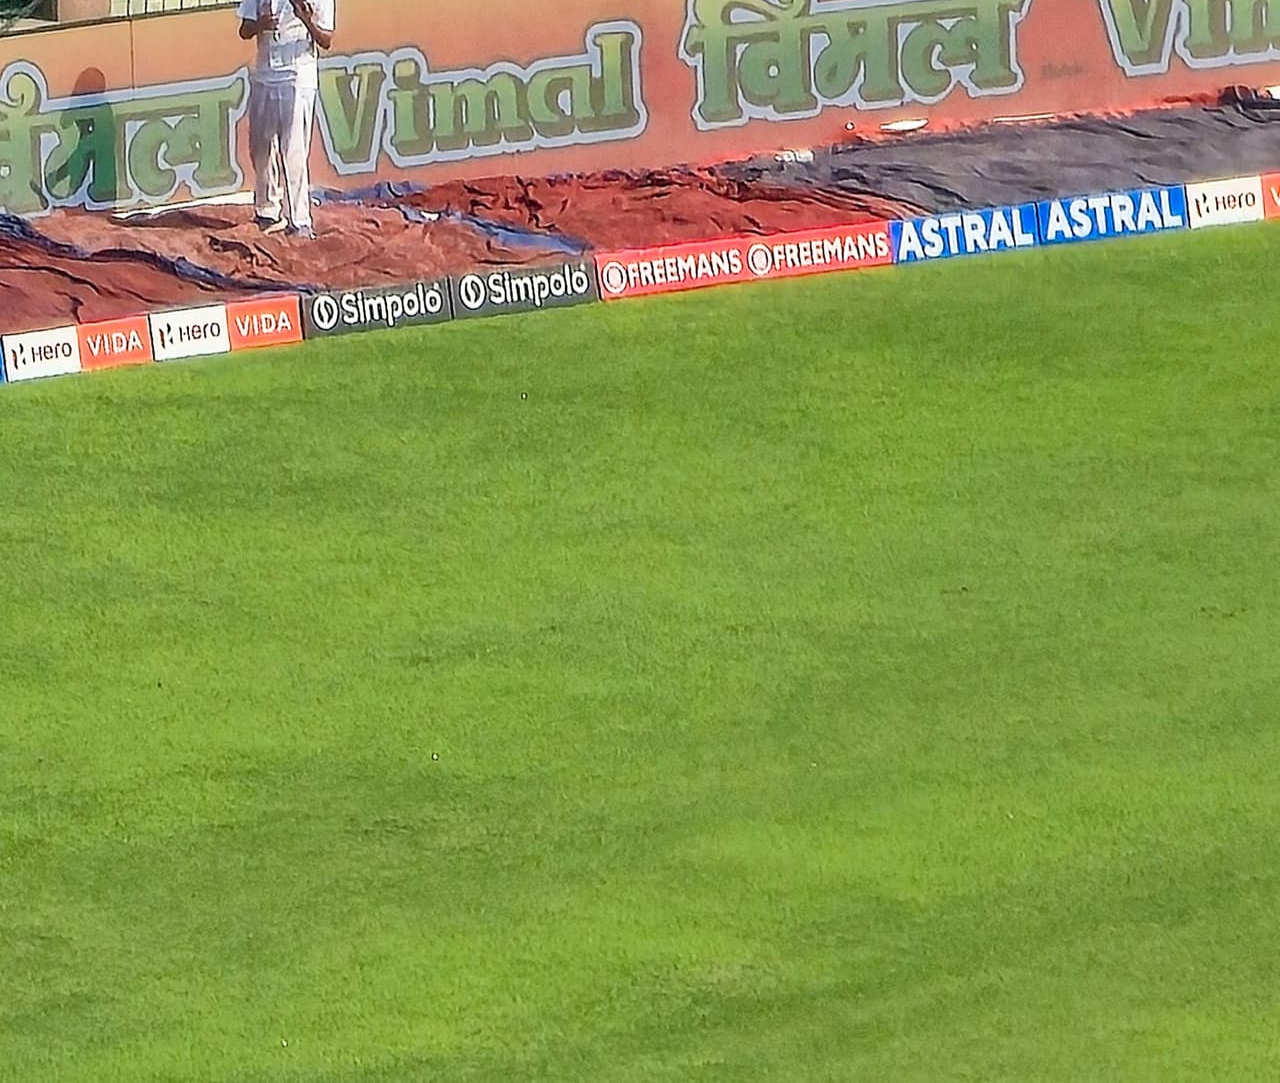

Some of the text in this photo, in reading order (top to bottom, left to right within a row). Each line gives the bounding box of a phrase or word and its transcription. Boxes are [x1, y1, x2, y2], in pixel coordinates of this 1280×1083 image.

[319, 33, 639, 162] Vimal
[899, 190, 1183, 261] ASTRAL ASTRAL
[1215, 191, 1256, 211] Hero
[628, 232, 889, 287] FREEMANS FREEMANS
[31, 310, 292, 363] Hero VIDA Hero VIDA
